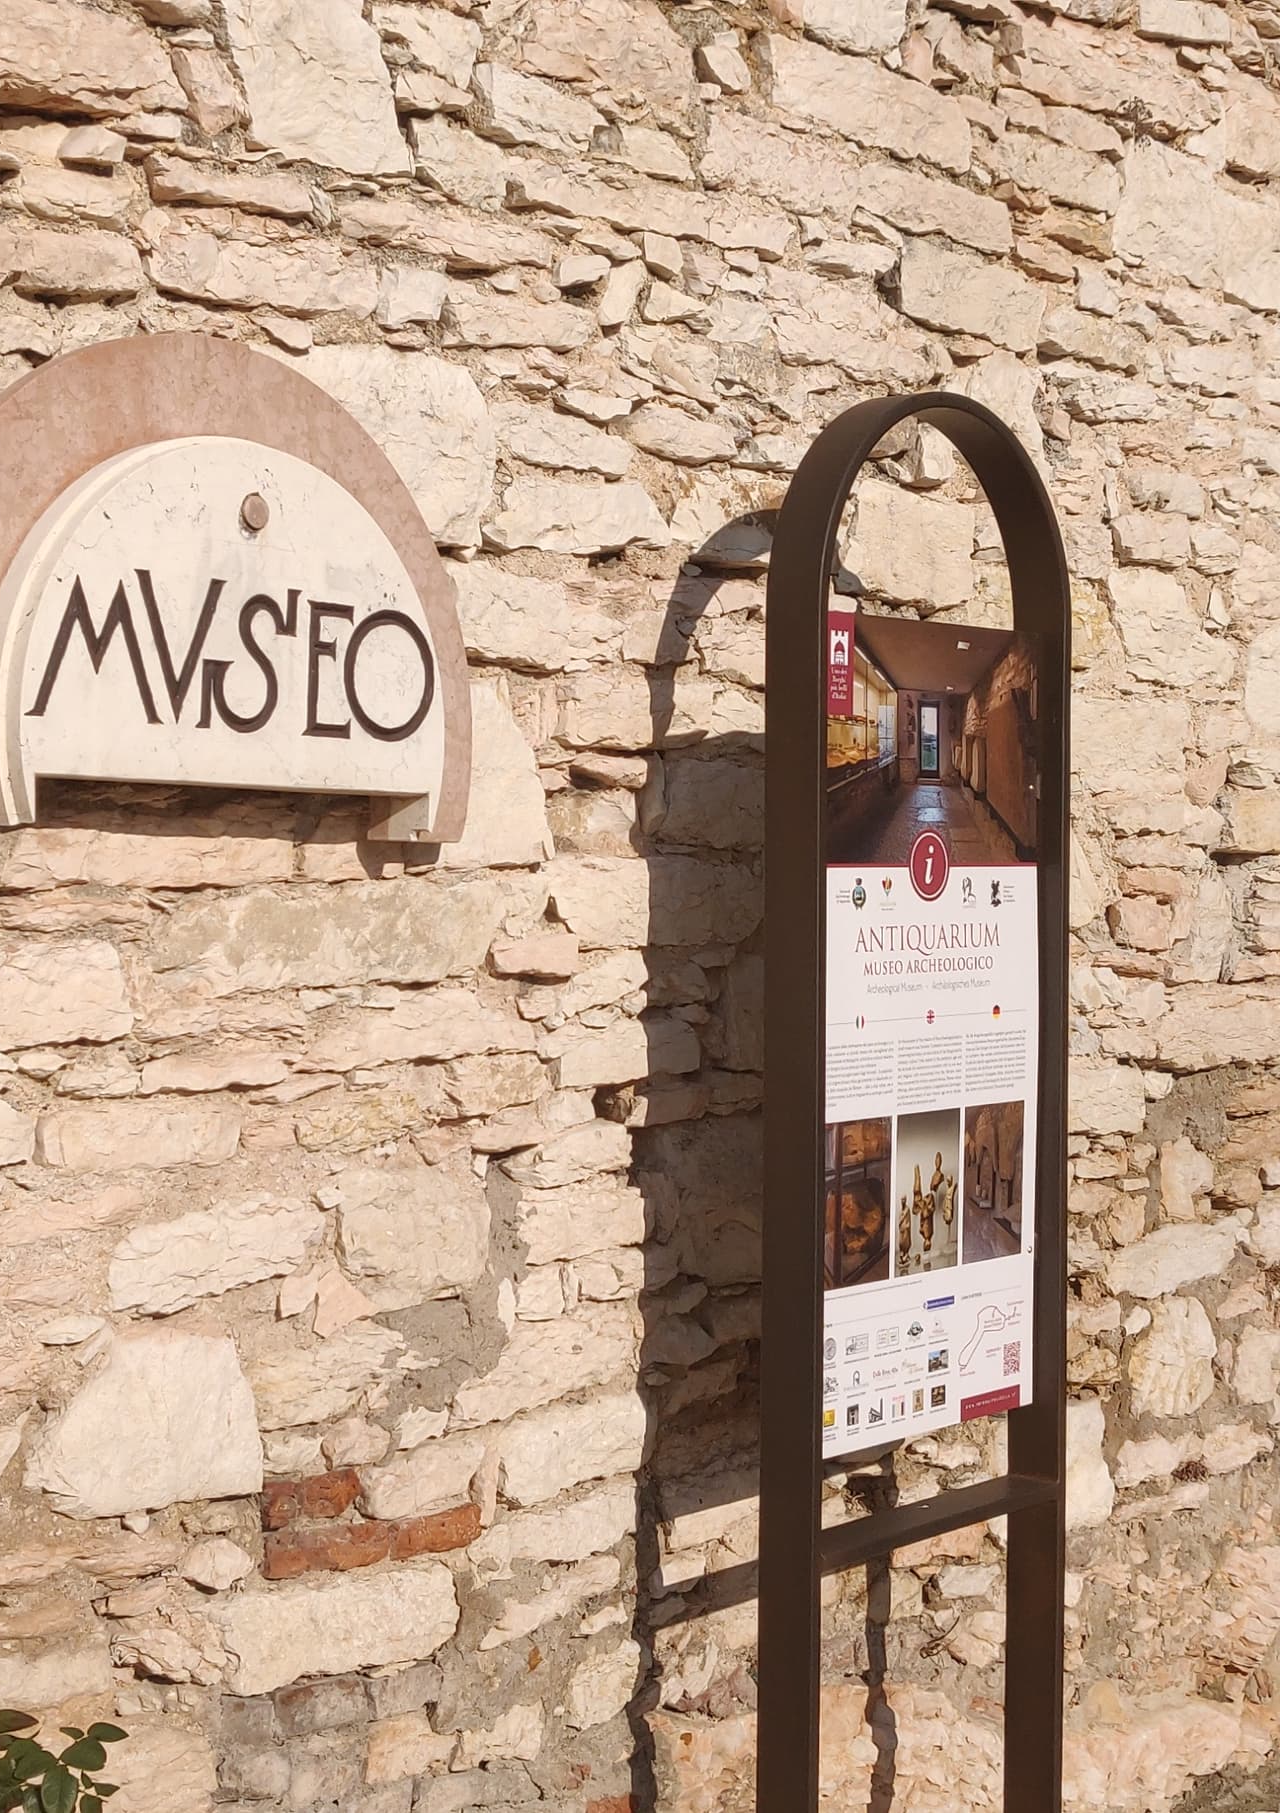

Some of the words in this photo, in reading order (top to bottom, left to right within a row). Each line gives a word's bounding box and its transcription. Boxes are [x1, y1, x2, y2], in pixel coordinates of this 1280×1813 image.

[924, 845, 936, 885] i
[855, 923, 1000, 956] ANTIQUARIUM
[863, 960, 903, 976] MUSEO
[906, 956, 993, 974] ARCHEOLOGICO
[901, 980, 923, 992] Museum
[970, 976, 991, 988] Museum
